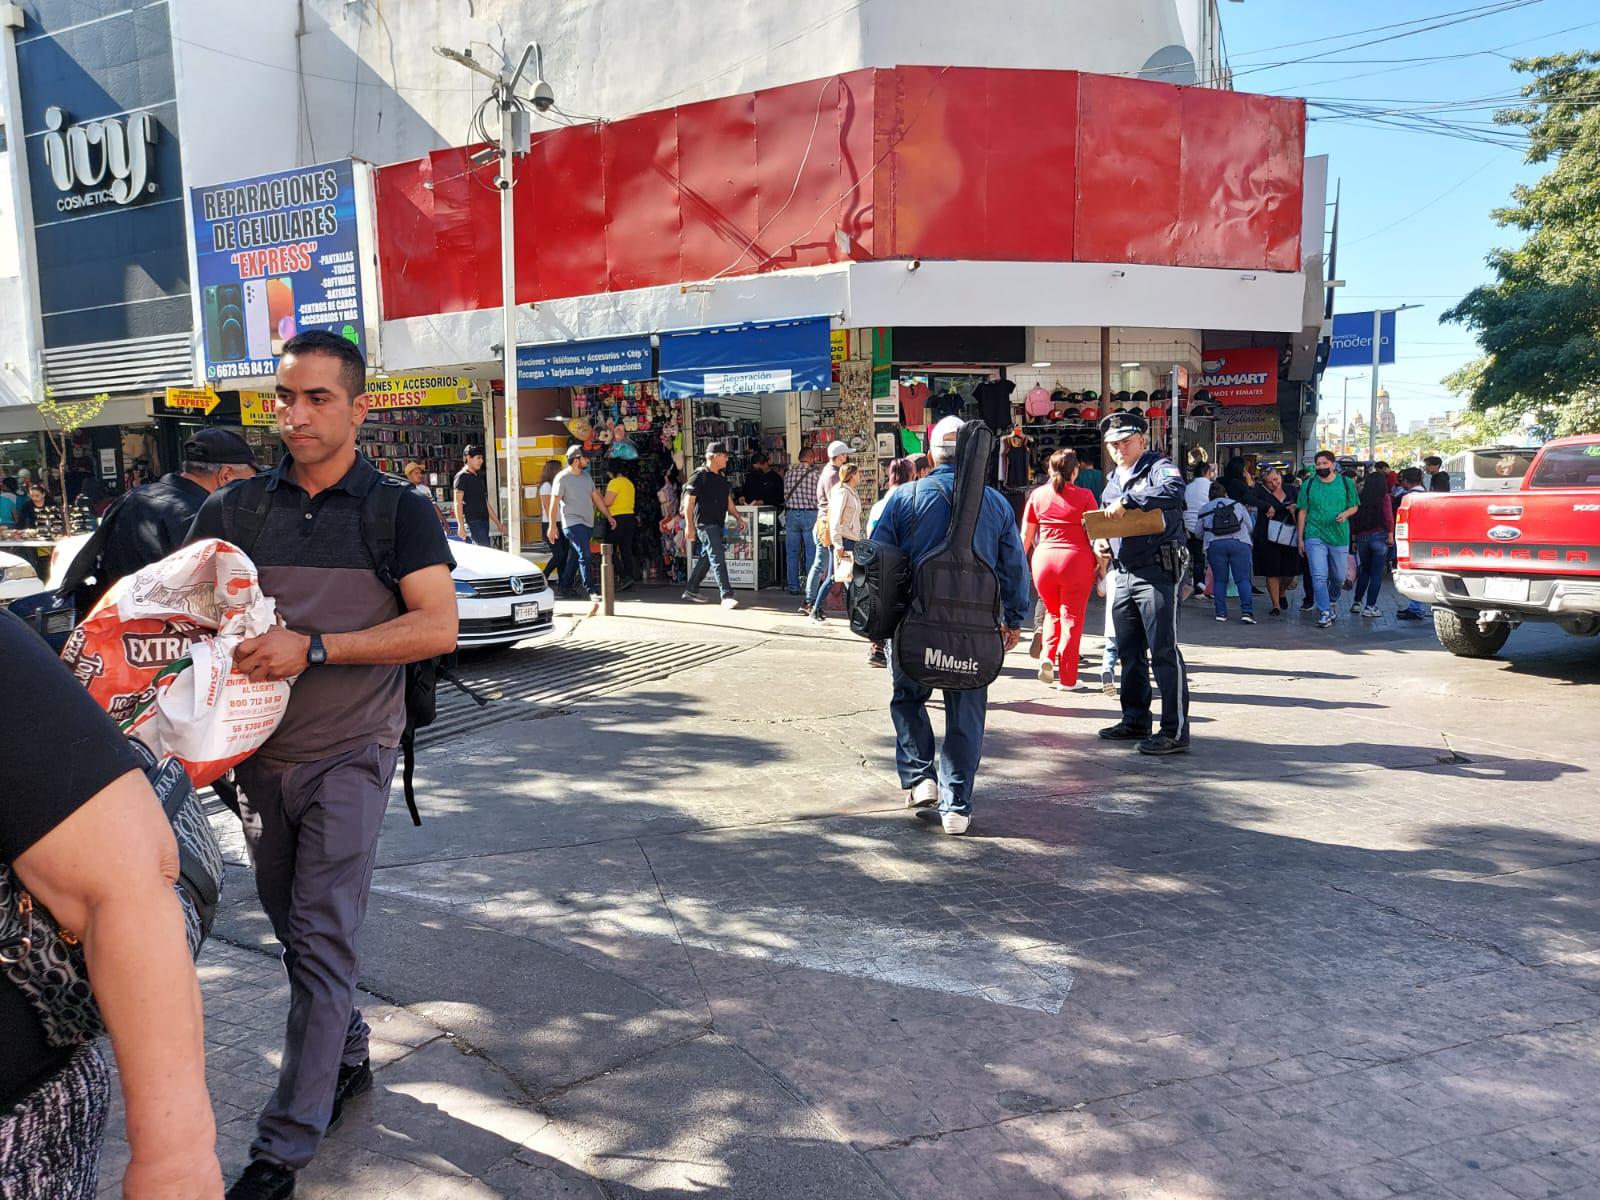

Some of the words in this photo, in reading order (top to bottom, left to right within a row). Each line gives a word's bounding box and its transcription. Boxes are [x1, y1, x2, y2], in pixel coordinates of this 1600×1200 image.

[44, 106, 153, 204] ivy
[203, 168, 338, 221] REPARACIONES
[213, 221, 236, 252] DE
[238, 204, 338, 248] CELULARES
[1332, 336, 1390, 349] modera
[587, 351, 620, 362] Accesorios
[216, 363, 237, 378] 6673
[239, 362, 249, 376] 55
[250, 361, 262, 375] 84
[551, 367, 575, 379] Tarjetas
[575, 365, 594, 377] Amigo
[600, 362, 642, 375] Reparaciones
[394, 379, 401, 390] Y
[403, 376, 458, 390] ACCESORIOS
[723, 372, 772, 385] Reparación
[720, 383, 730, 393] de
[733, 382, 776, 392] Celulares
[1431, 547, 1589, 563] RANGER
[129, 637, 192, 663] EXTRA
[206, 666, 219, 706] minsa
[252, 684, 275, 692] CLIENTE
[230, 699, 247, 708] 800
[250, 698, 263, 706] 712
